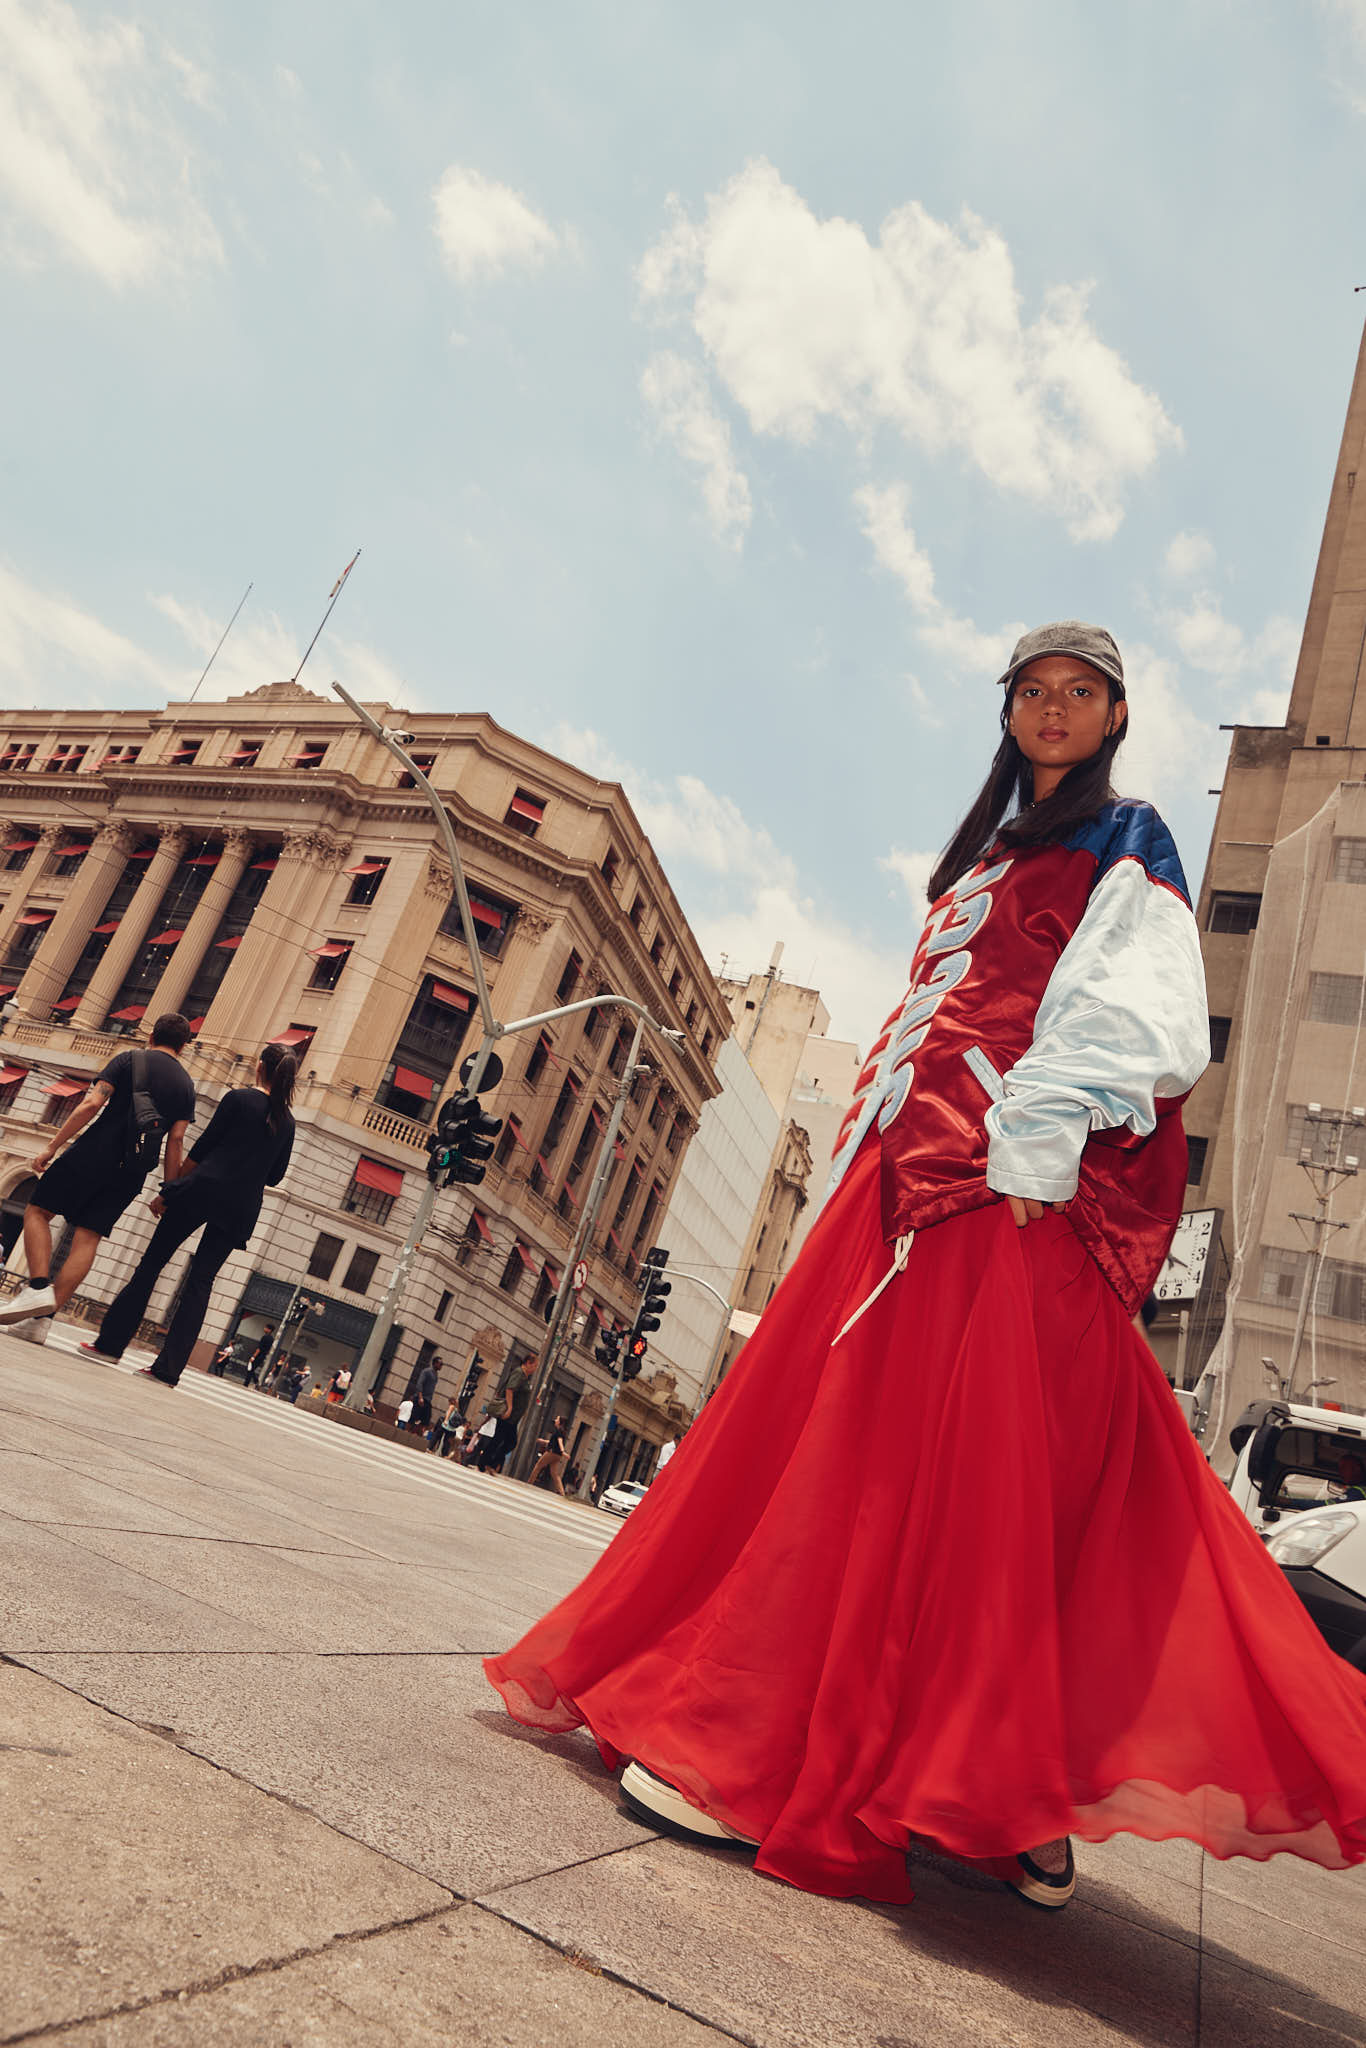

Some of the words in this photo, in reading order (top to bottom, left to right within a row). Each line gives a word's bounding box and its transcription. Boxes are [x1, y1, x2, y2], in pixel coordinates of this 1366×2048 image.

[1188, 1215, 1194, 1228] 1
[1201, 1222, 1210, 1235] 2
[1196, 1247, 1206, 1261] 3
[1193, 1270, 1201, 1284] 4
[1160, 1284, 1168, 1297] 6
[1174, 1283, 1182, 1297] 5
